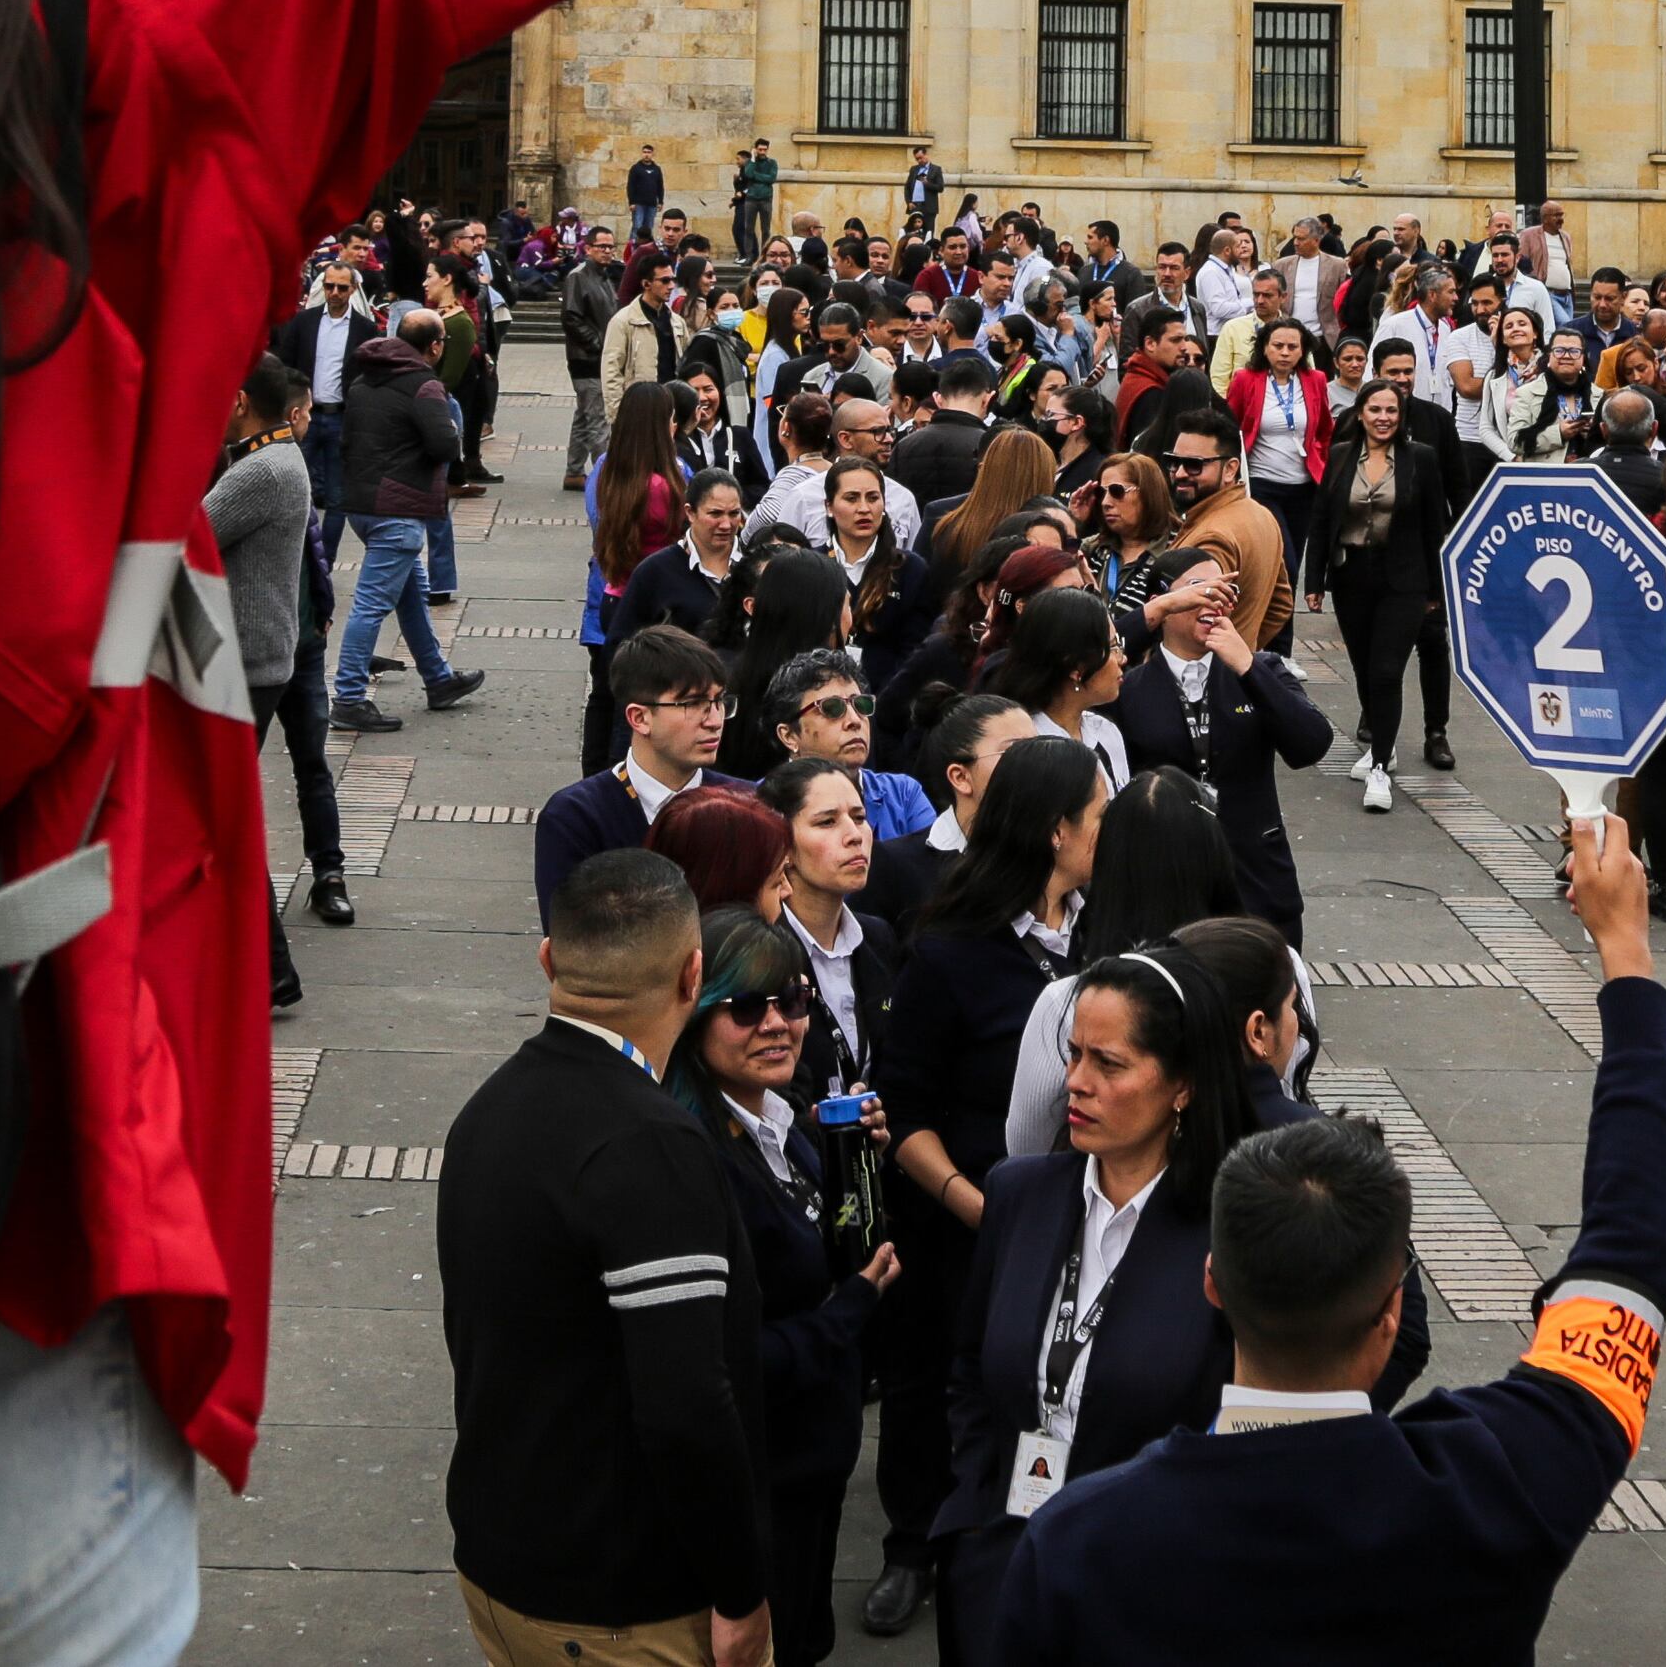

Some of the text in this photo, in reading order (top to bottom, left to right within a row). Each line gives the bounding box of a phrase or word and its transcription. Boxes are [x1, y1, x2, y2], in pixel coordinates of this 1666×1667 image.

[1465, 502, 1664, 612] PUNTO DE ENCUENTRO
[1536, 537, 1572, 554] PISO
[1525, 554, 1605, 673] 2
[1579, 706, 1613, 720] MinTIC
